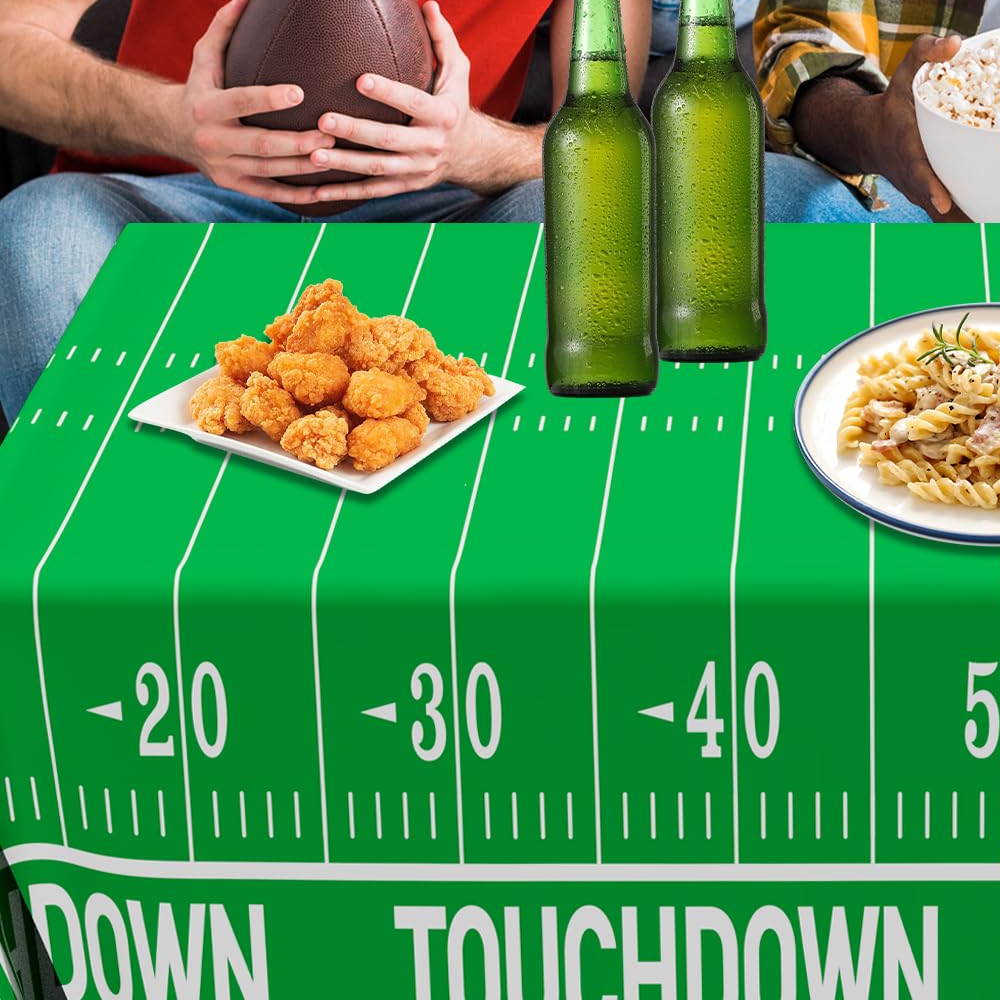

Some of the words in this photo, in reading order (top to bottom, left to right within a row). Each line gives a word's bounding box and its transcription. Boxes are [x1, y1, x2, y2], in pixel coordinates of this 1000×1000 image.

[136, 662, 228, 758] 20
[411, 662, 502, 761] 30
[687, 661, 781, 758] 40
[394, 904, 939, 1000] TOUCHDOWN
